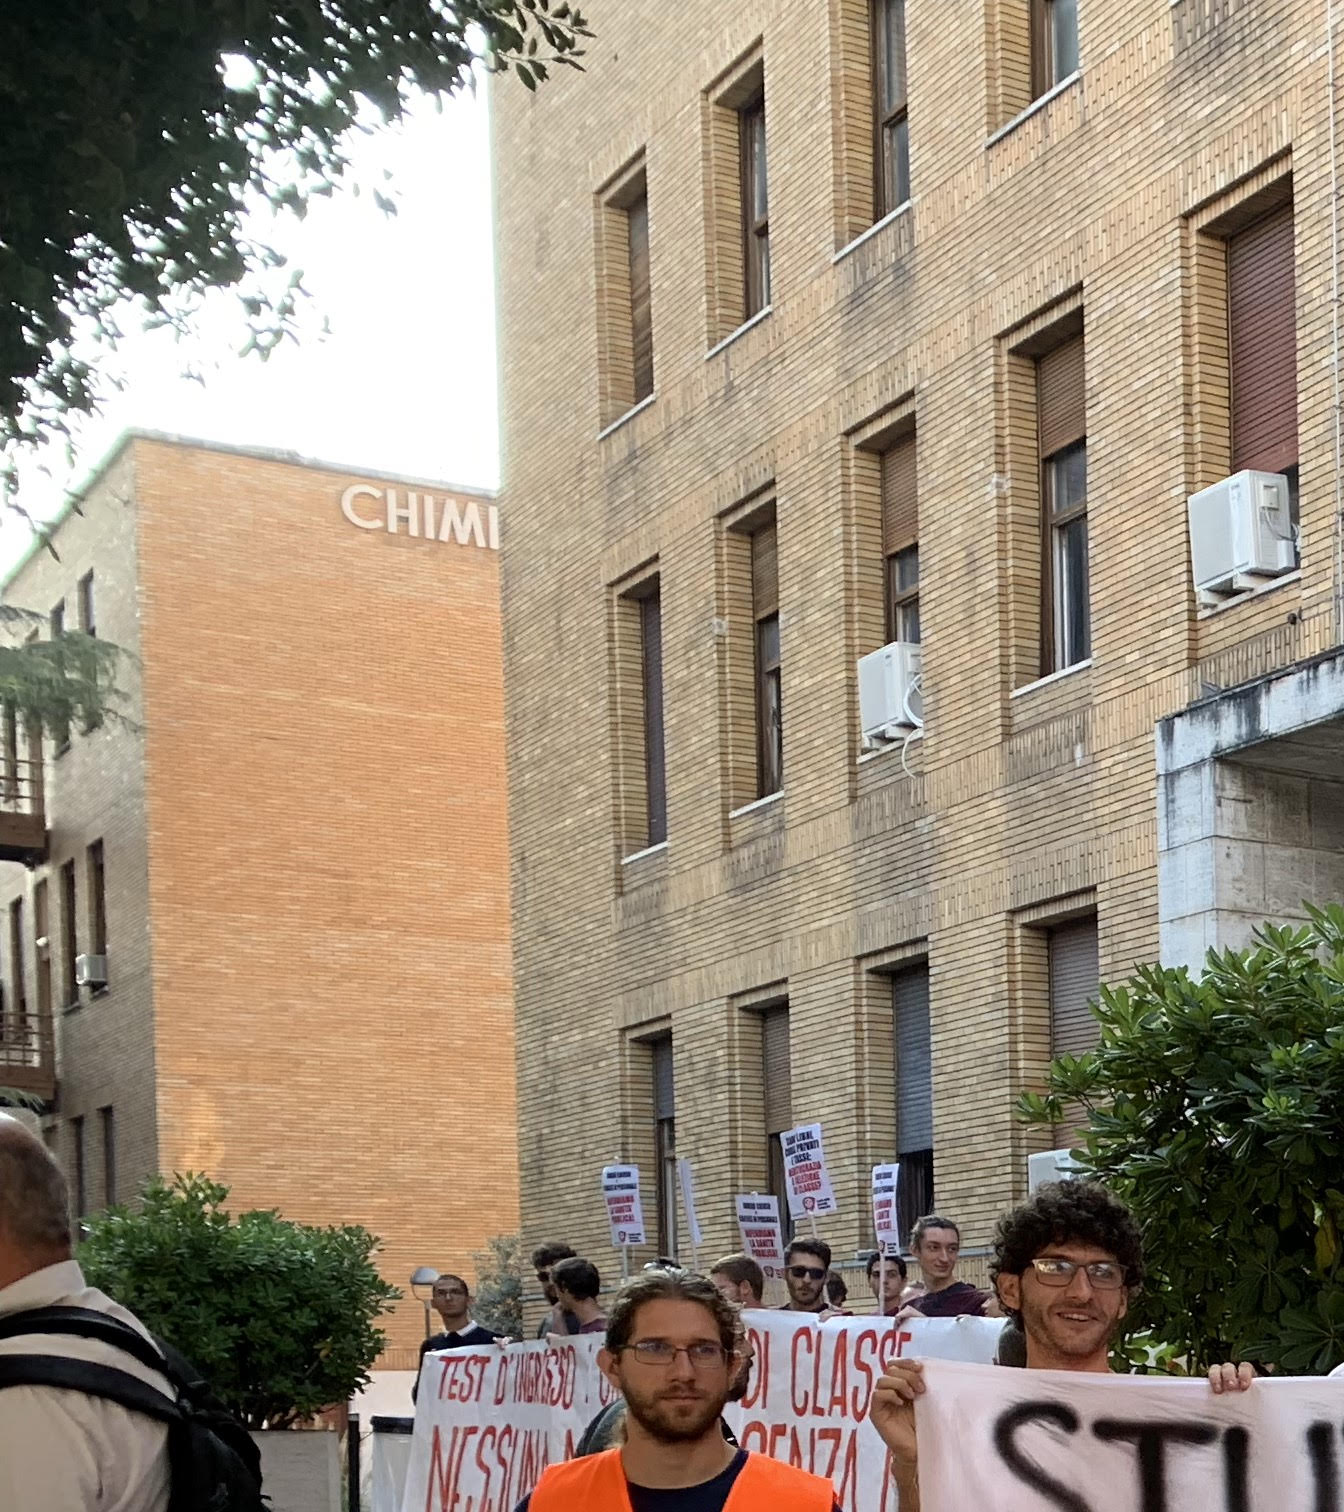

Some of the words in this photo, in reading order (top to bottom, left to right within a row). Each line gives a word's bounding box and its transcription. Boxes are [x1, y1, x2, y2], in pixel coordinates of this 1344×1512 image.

[341, 484, 499, 549] CHIMI
[438, 1354, 491, 1403] TEST
[791, 1326, 912, 1424] CLASS
